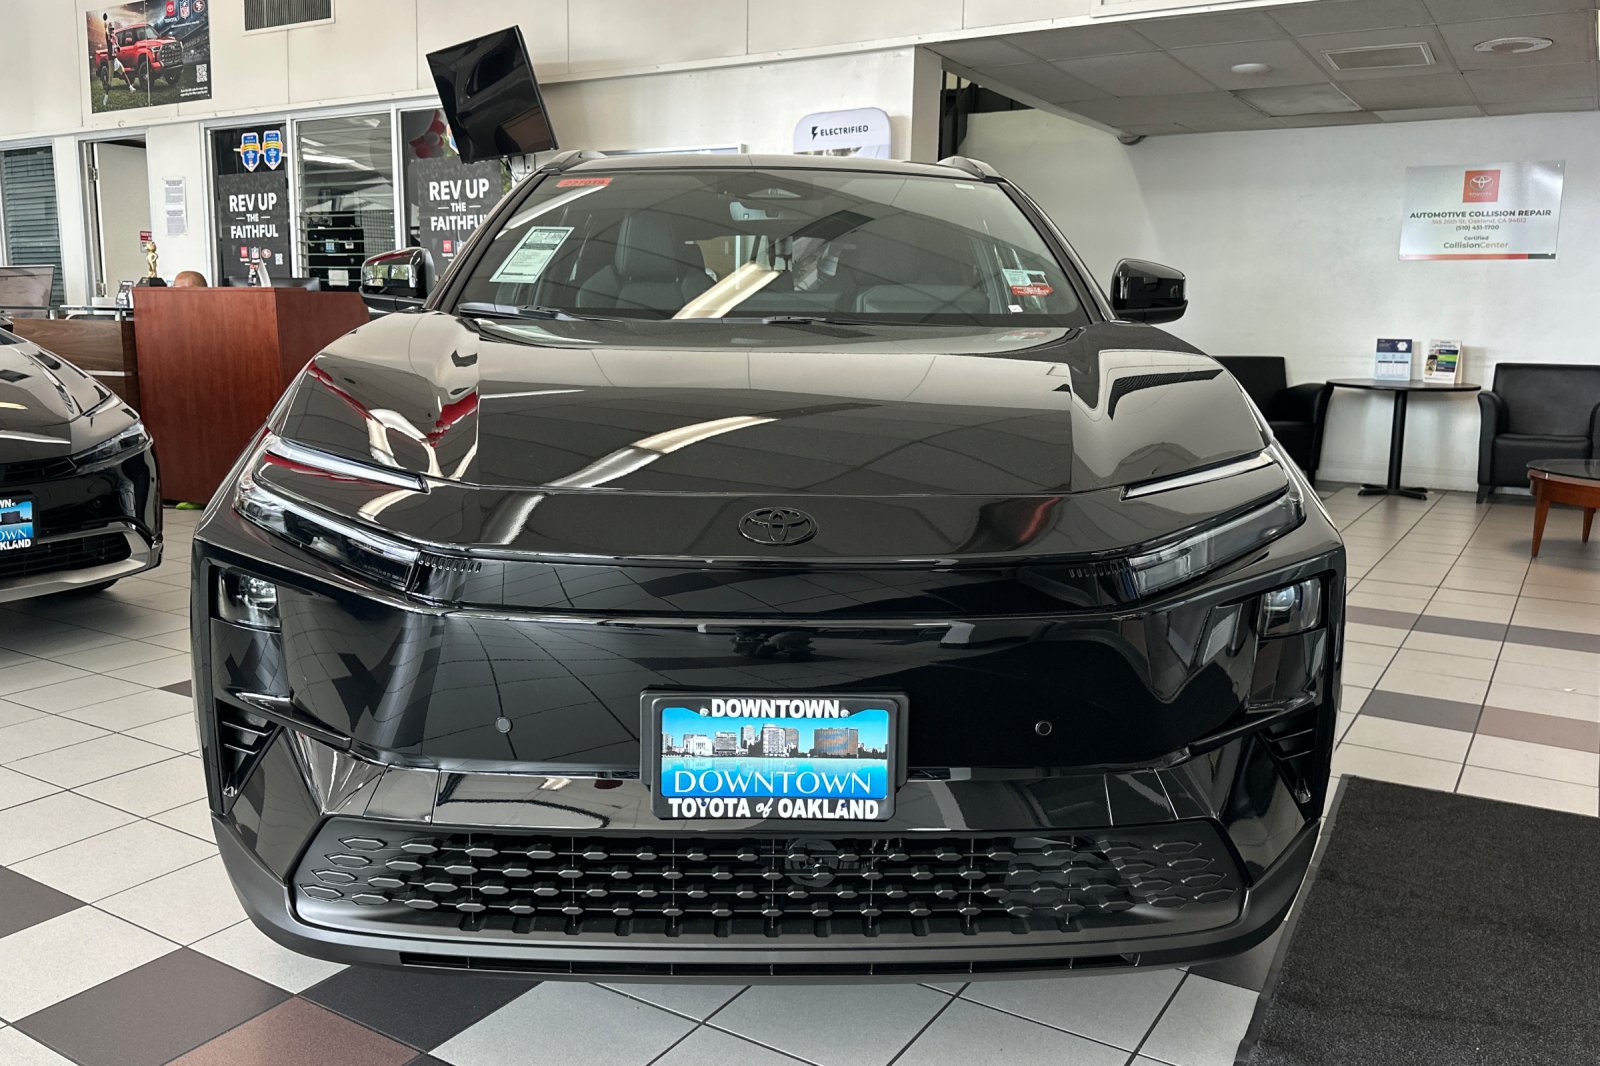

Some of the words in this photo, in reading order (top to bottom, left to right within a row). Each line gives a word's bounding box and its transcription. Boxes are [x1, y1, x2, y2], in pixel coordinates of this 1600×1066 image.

[820, 125, 869, 137] ELECTRIFIED
[429, 180, 462, 201] REV
[466, 178, 490, 199] UP
[229, 194, 256, 212] REV
[258, 192, 277, 211] UP
[451, 202, 467, 213] THE
[246, 213, 260, 222] THE
[430, 214, 487, 232] FAITHFU
[1410, 211, 1467, 219] AUTOMOTIVE
[1468, 210, 1516, 218] COLLISION
[1518, 209, 1551, 217] REPAIR
[231, 224, 279, 239] FAITHFUL
[711, 698, 840, 719] DOWNTOWN
[674, 770, 871, 794] DOWNTOWN
[668, 798, 751, 818] TOYOTA
[756, 798, 774, 818] of
[777, 799, 879, 820] OAKLAND
